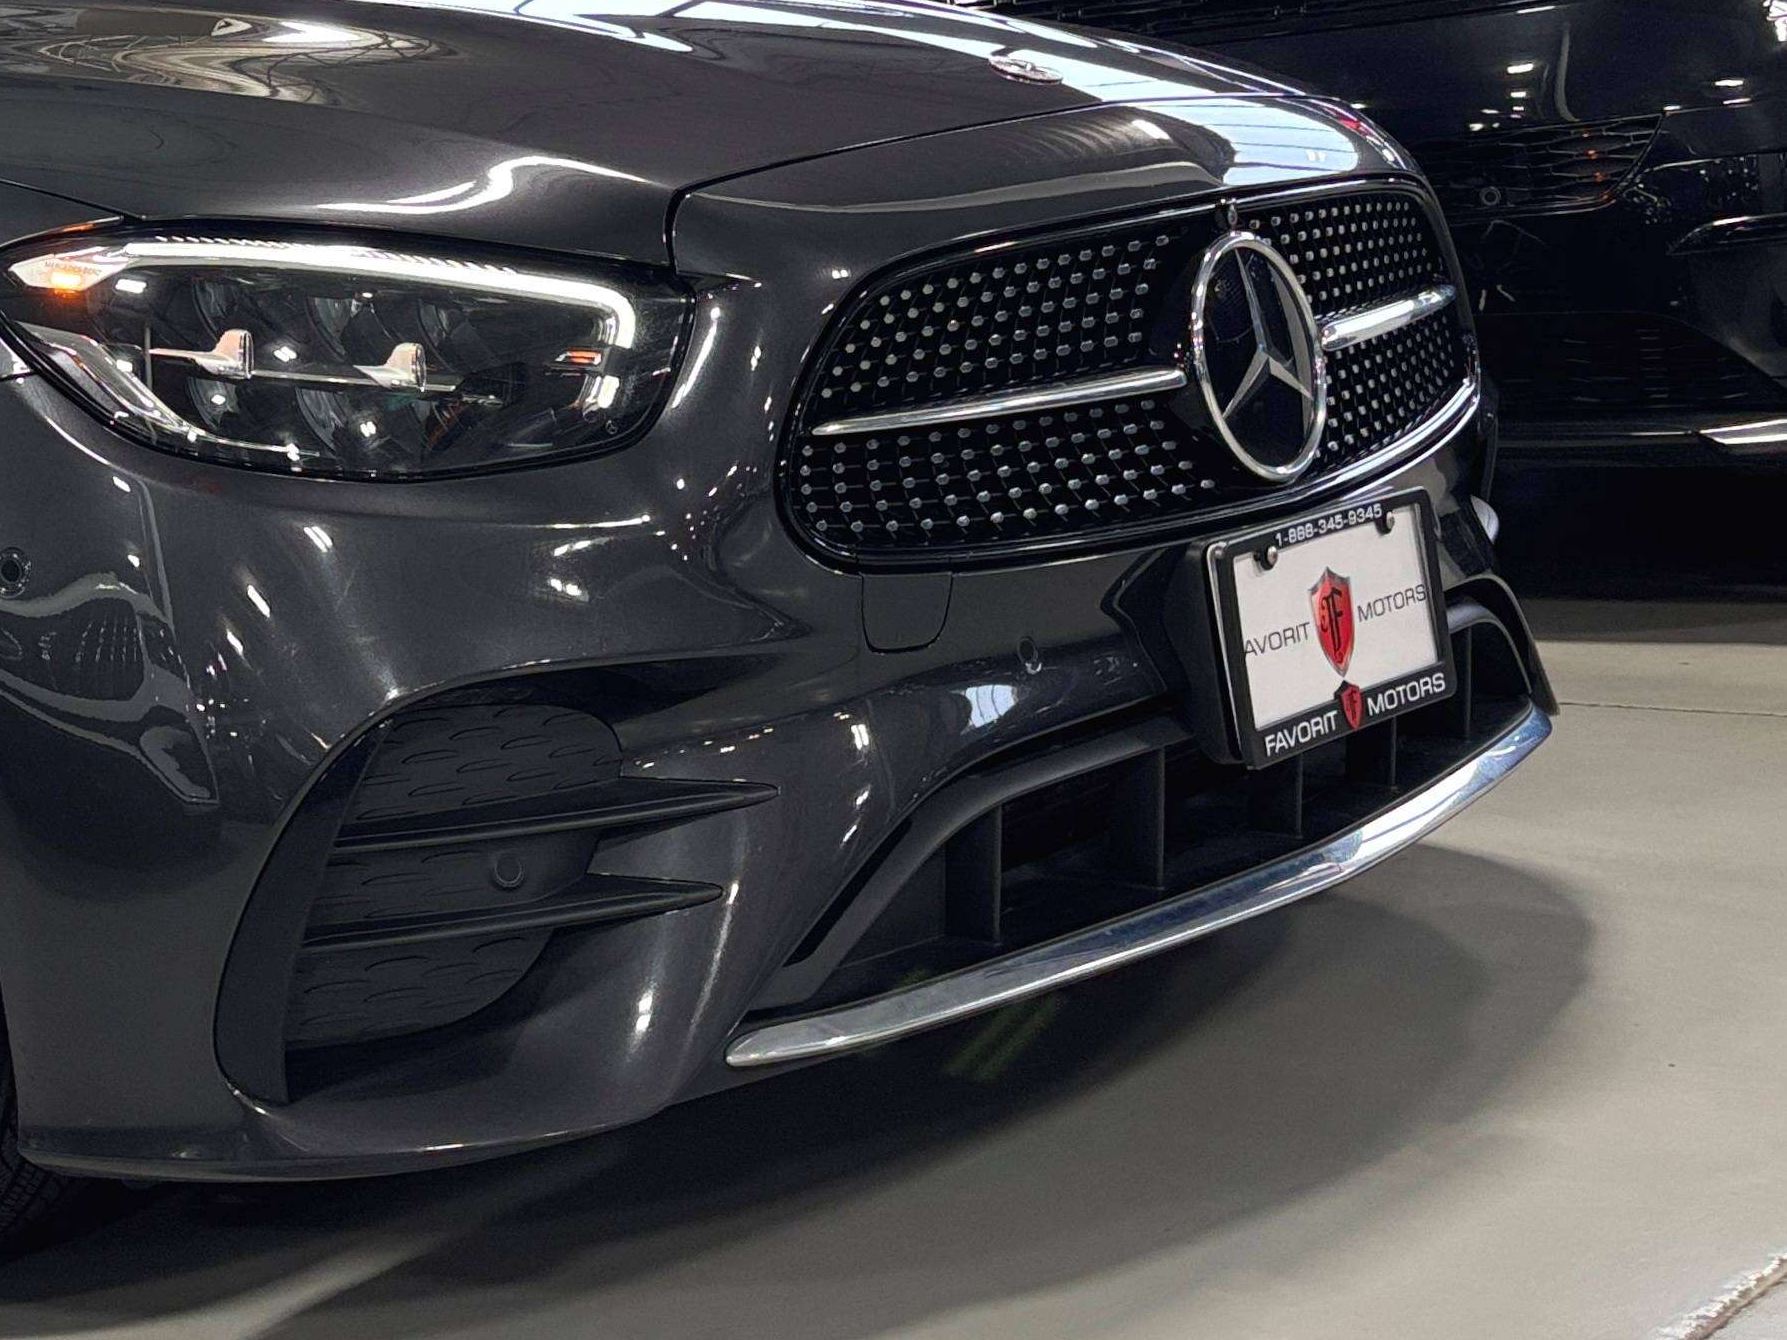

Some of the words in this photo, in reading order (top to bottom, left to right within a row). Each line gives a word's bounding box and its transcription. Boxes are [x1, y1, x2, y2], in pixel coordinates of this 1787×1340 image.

[1357, 583, 1427, 623] MOTORS
[1265, 710, 1338, 757] FAVORIT
[1367, 672, 1447, 717] MOTORS
